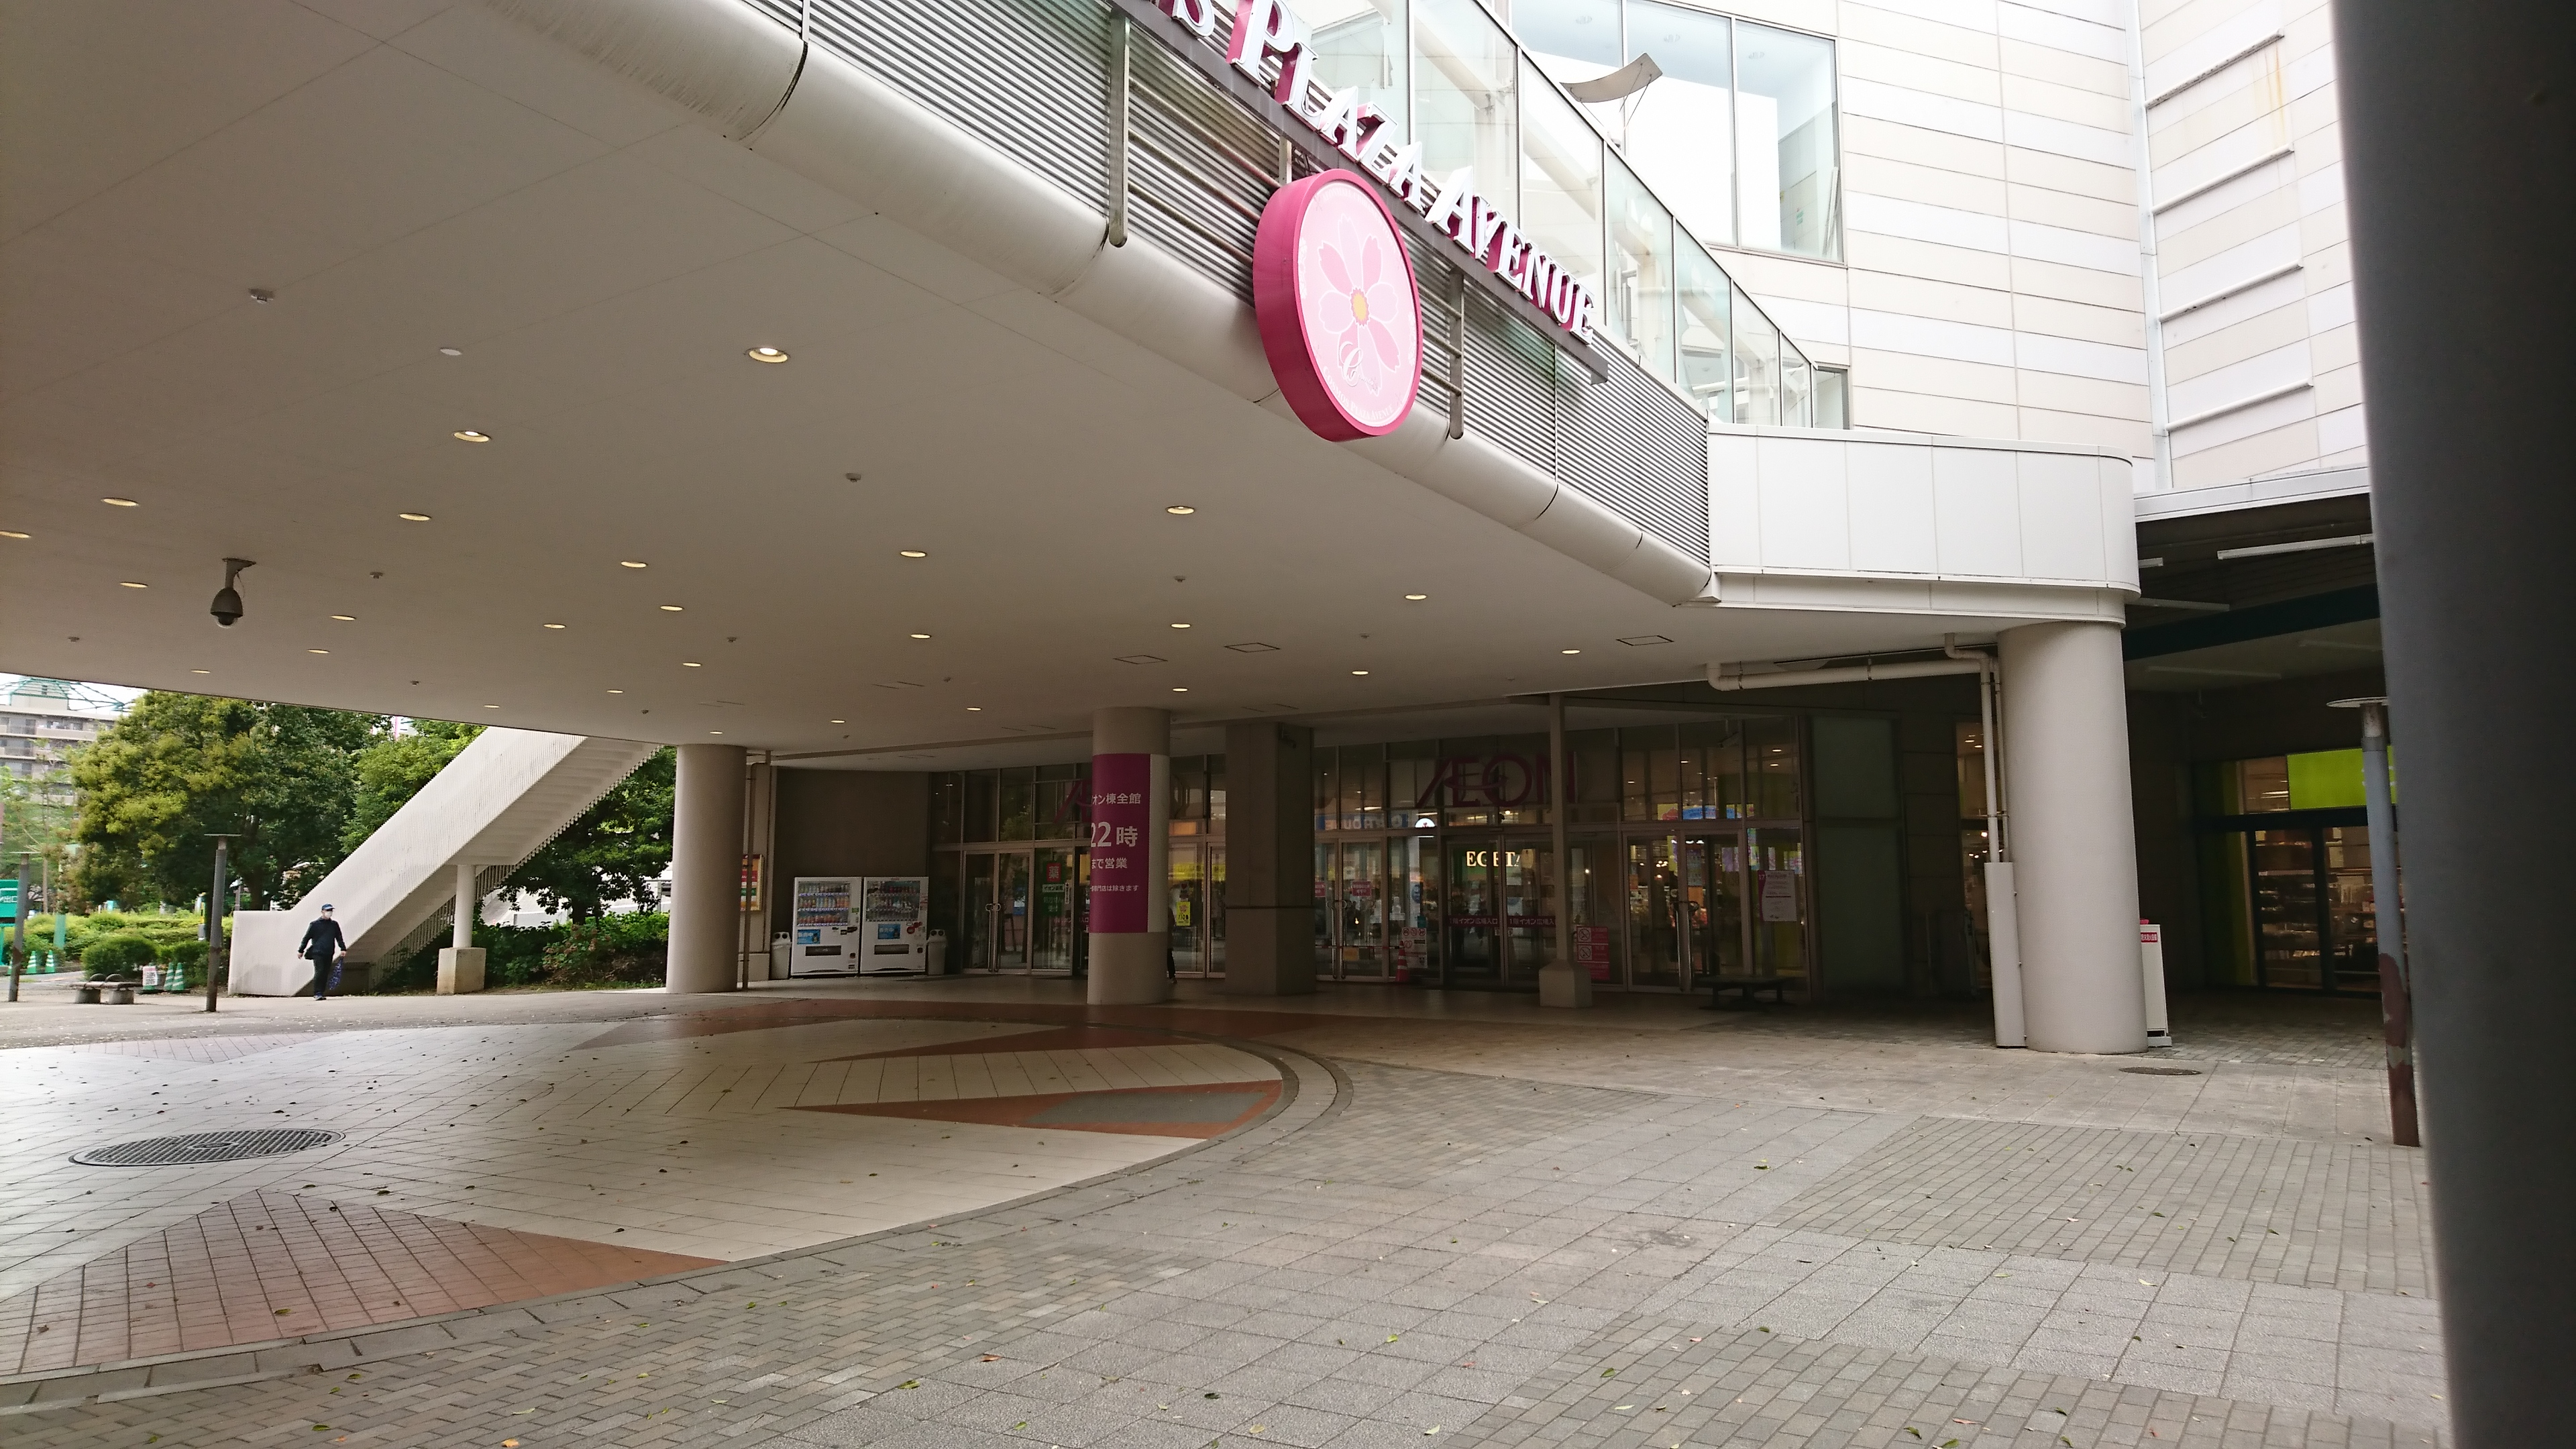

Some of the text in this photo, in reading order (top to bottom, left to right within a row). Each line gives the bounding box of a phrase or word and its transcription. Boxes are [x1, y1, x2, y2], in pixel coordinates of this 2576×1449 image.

[1226, 0, 1595, 345] PLAZA AVENUE
[1323, 366, 1350, 407] COSMOS
[1091, 793, 1141, 805] オン棟全館
